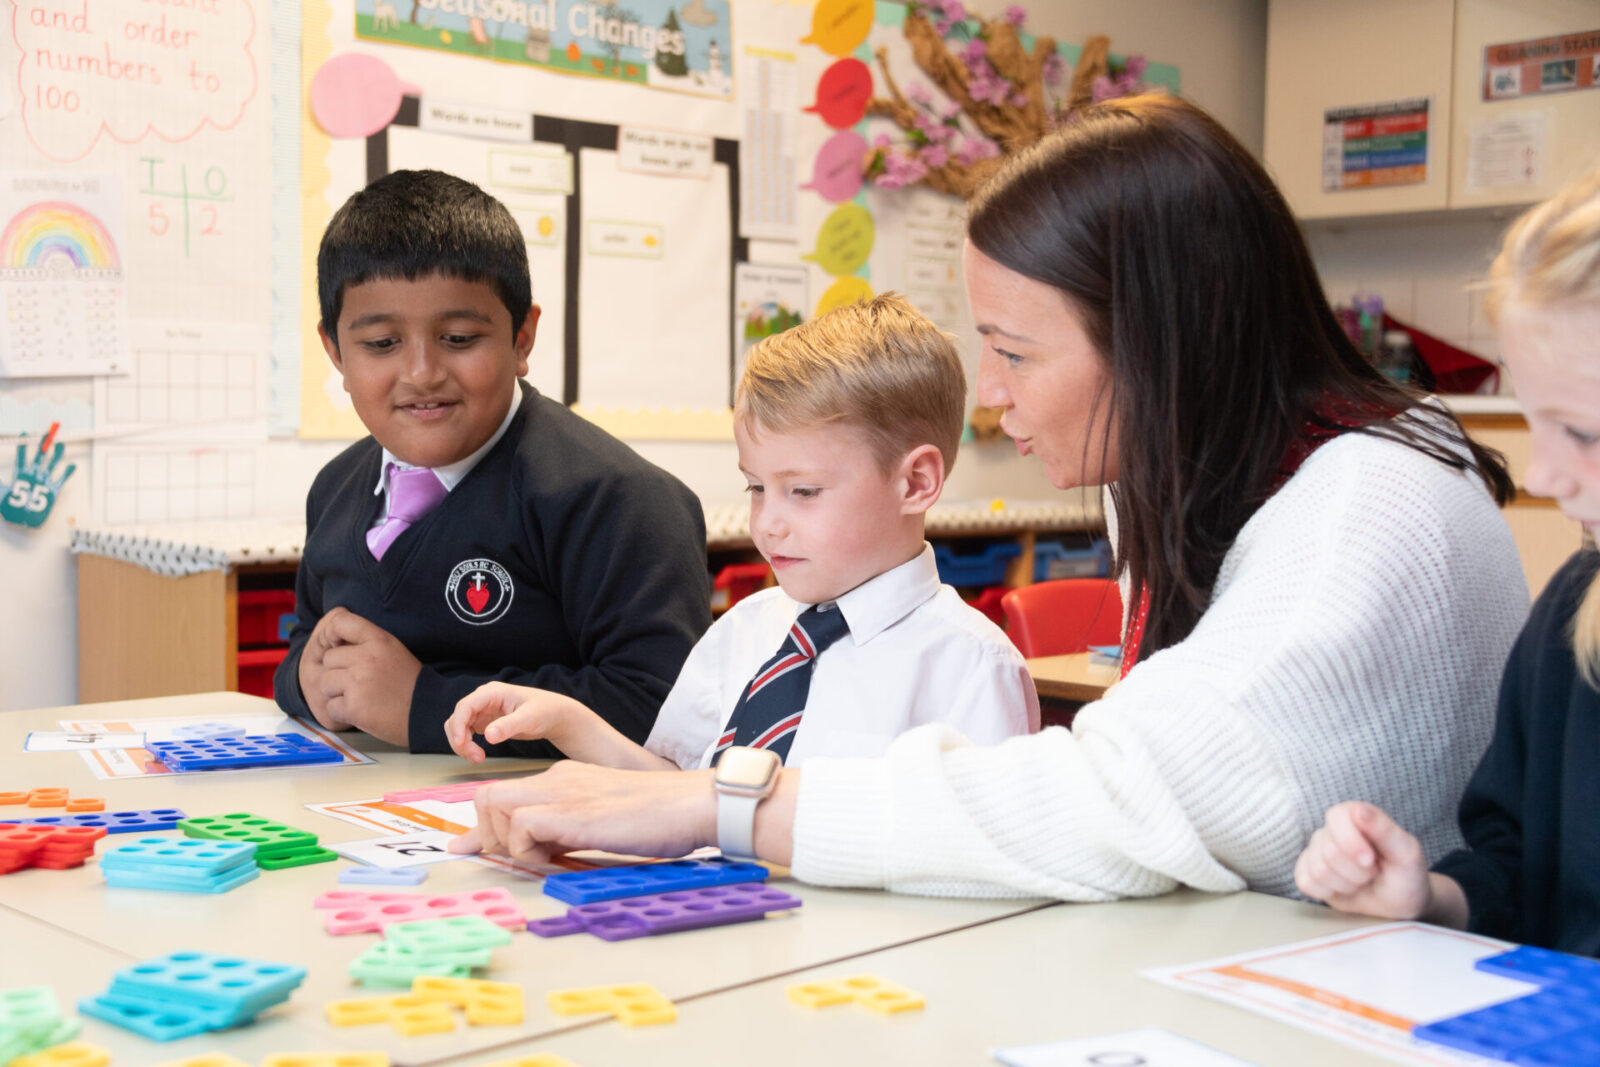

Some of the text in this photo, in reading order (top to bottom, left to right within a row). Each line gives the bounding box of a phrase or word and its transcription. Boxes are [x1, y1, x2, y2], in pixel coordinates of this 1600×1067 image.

[31, 0, 198, 48] and order
[568, 3, 685, 59] Changes
[37, 40, 220, 92] numbers to
[36, 83, 80, 112] 100
[149, 203, 223, 236] 5 2
[8, 480, 49, 512] 55
